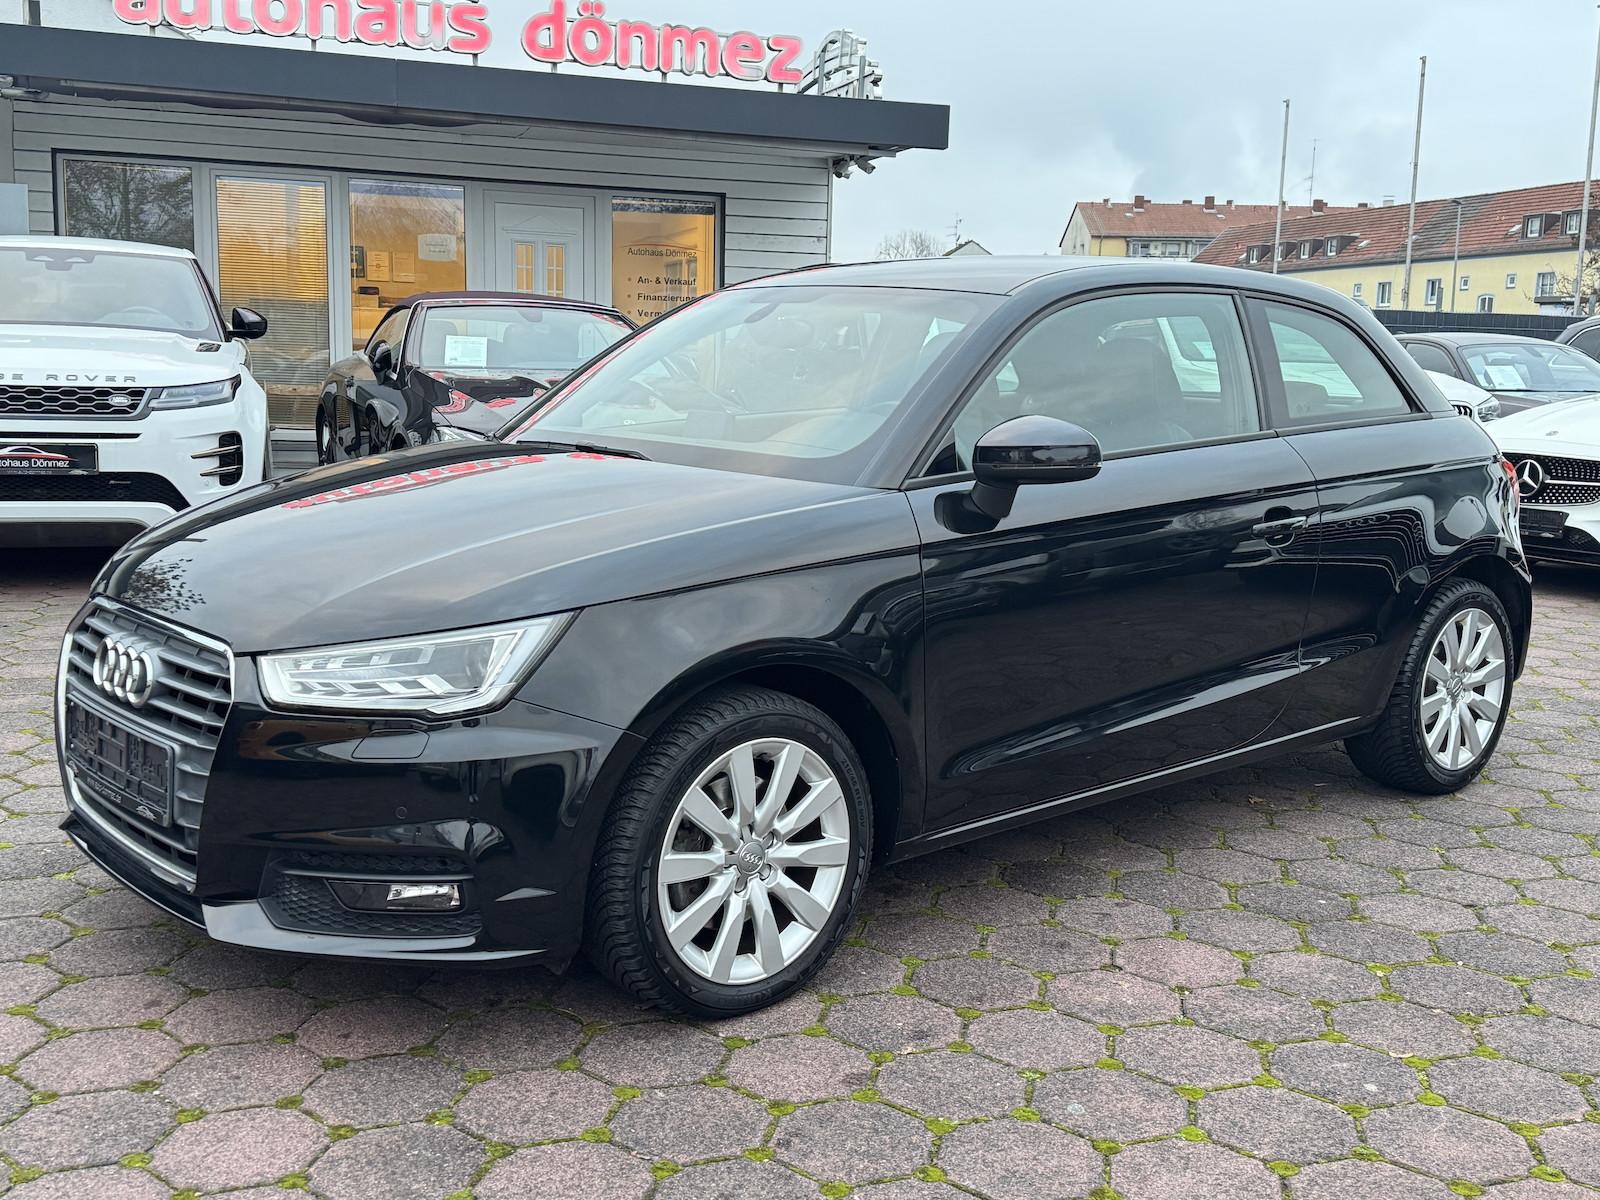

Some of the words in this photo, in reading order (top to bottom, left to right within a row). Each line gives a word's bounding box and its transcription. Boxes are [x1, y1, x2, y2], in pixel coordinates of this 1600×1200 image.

[521, 0, 803, 83] dönmez
[628, 248, 663, 257] Autohaus
[665, 248, 697, 258] Dönmez
[637, 276, 653, 285] An-
[655, 276, 661, 285] &
[664, 277, 696, 286] Verkauf
[46, 374, 136, 383] ROVER
[32, 458, 69, 468] Dönmez
